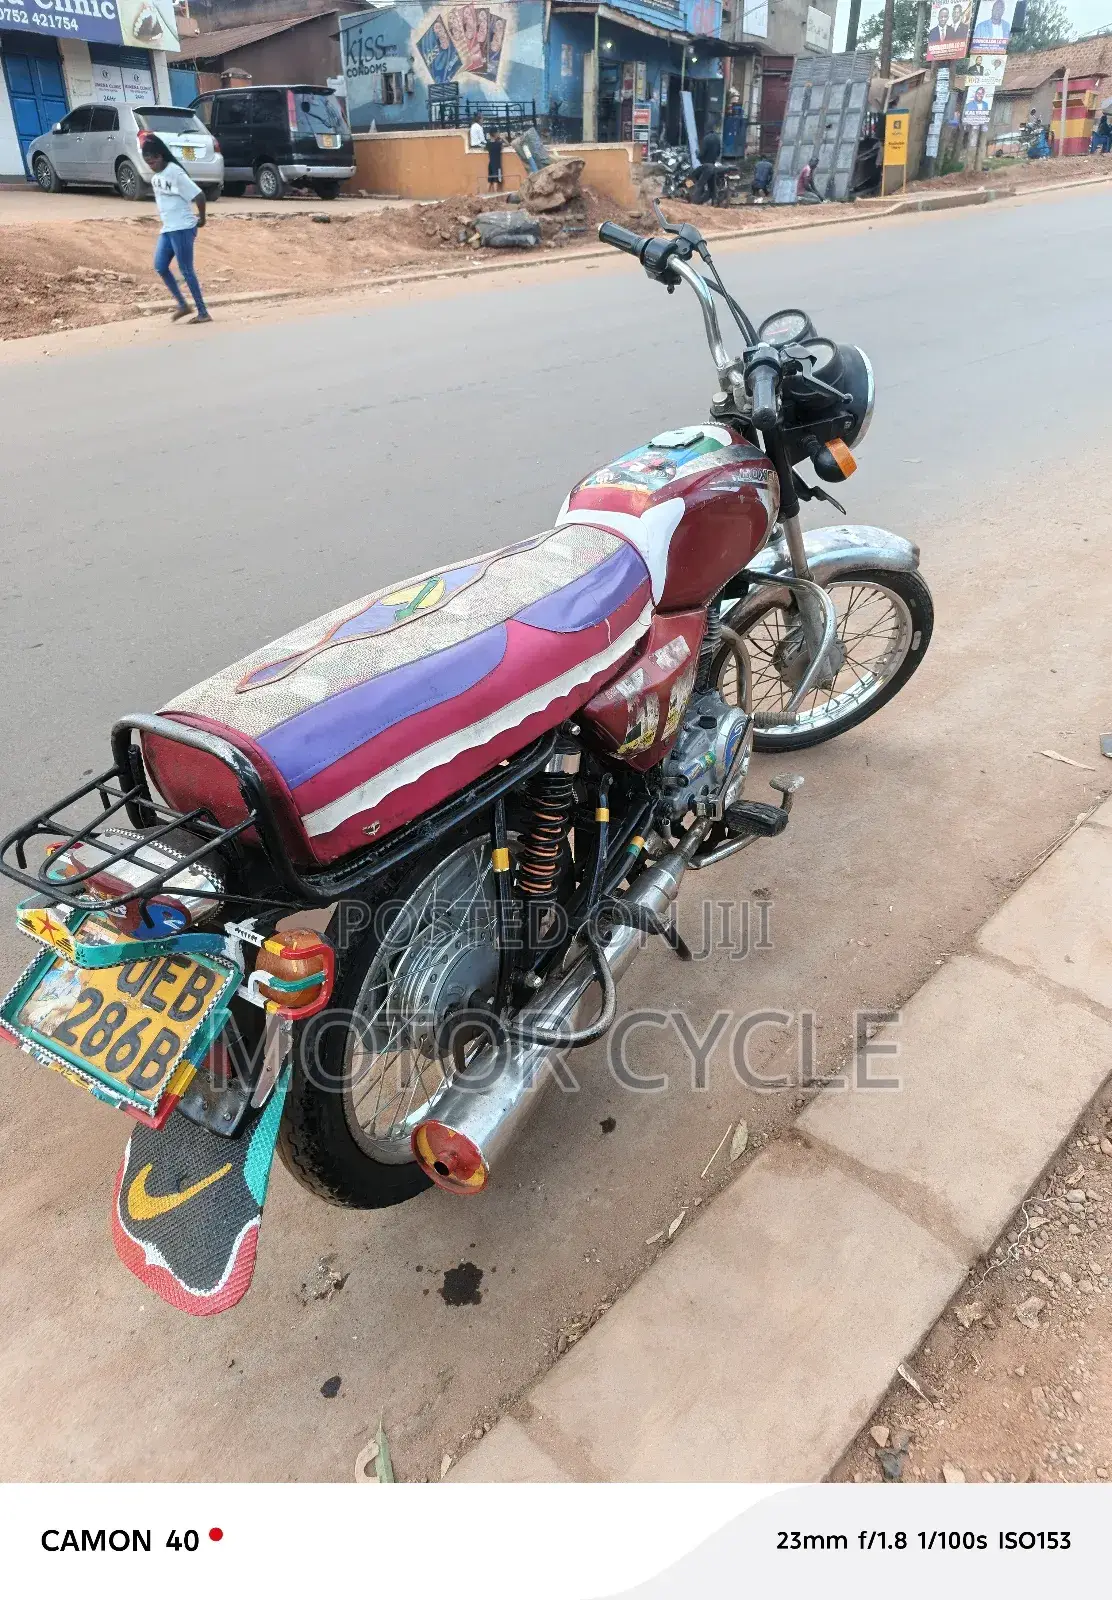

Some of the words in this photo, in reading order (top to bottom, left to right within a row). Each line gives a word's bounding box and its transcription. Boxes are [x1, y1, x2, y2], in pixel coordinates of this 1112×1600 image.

[32, 12, 79, 31] 421754
[345, 28, 397, 66] kiss
[346, 62, 388, 78] CONDOMS
[51, 987, 181, 1092] 286B
